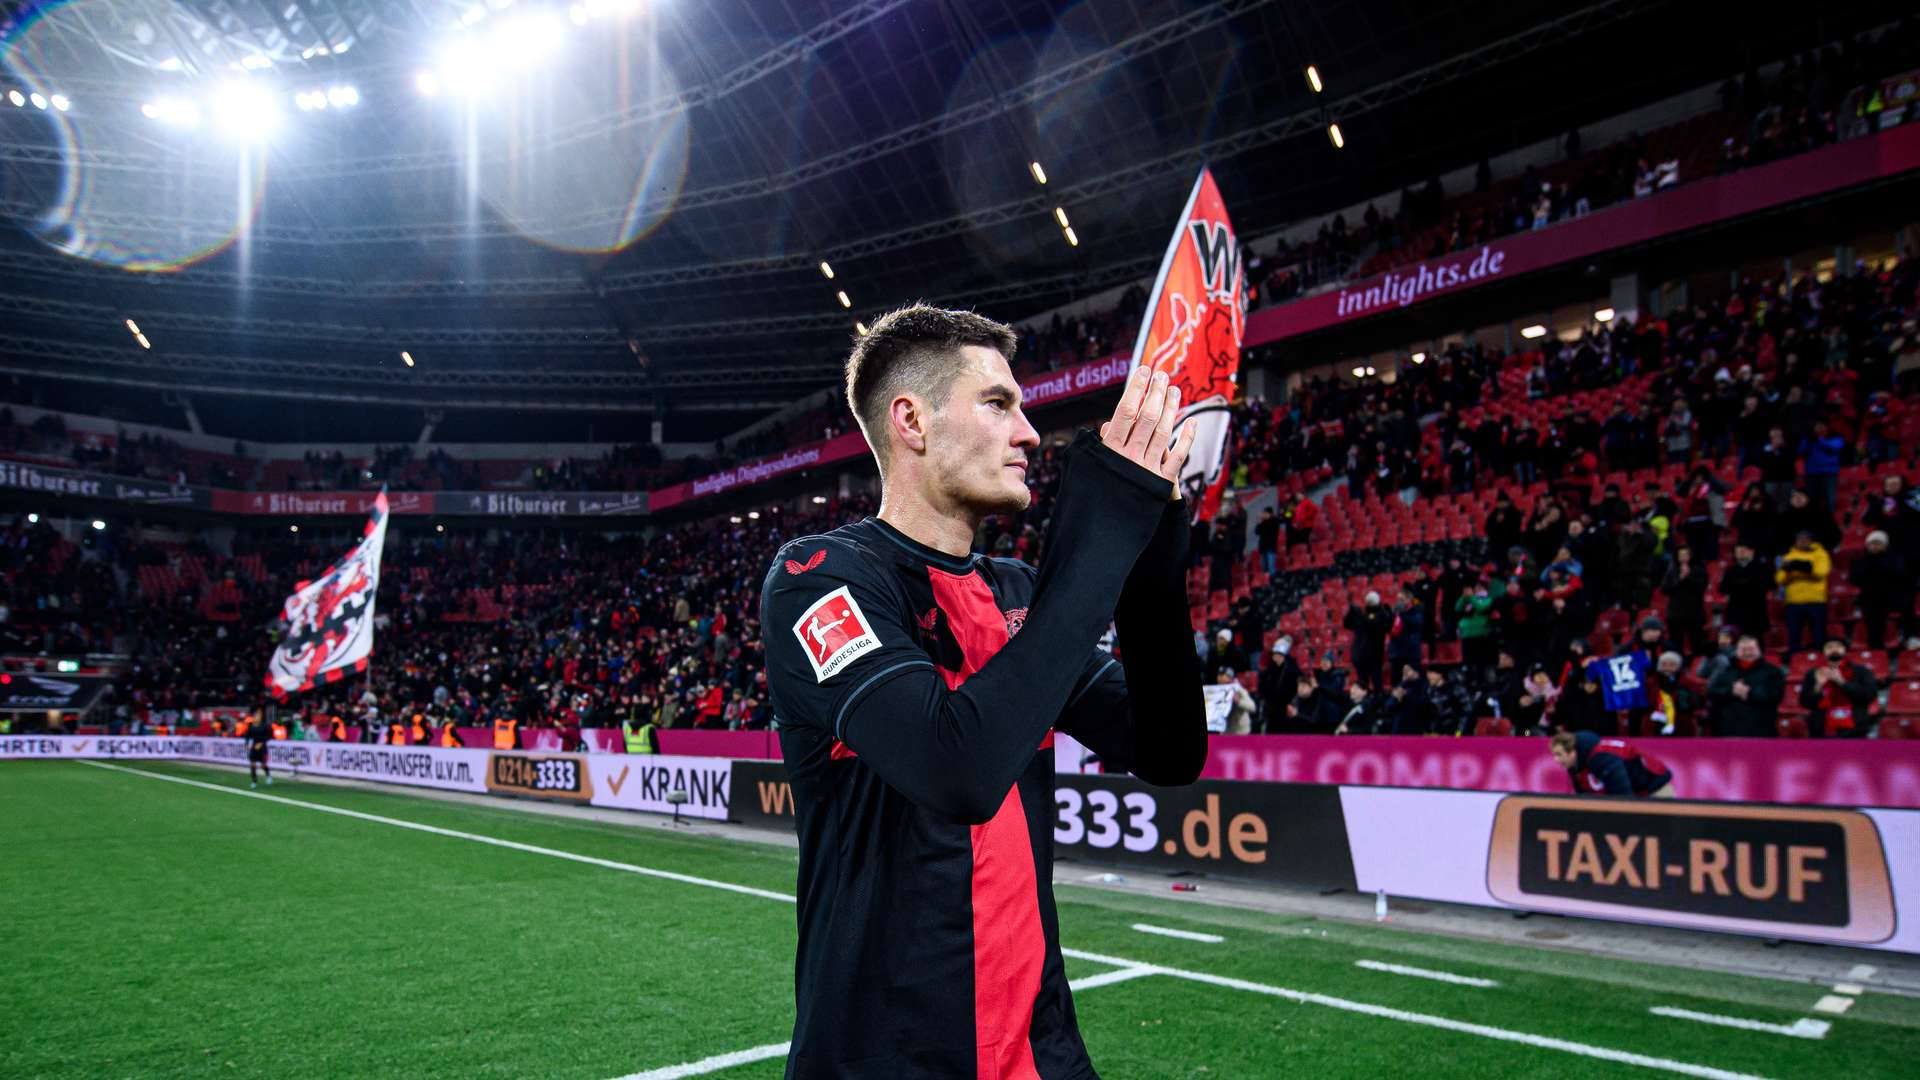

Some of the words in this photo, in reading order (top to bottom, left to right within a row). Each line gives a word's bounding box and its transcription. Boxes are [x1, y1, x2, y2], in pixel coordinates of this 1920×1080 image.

[1337, 246, 1505, 317] innlights.de
[1021, 372, 1071, 403] ormat
[487, 494, 567, 514] Bitburger
[822, 638, 873, 677] BUNDESLIGA
[325, 749, 432, 779] FLUGHAFENTRANSFER
[435, 760, 474, 784] u.v.m.
[641, 765, 730, 809] KRANK
[1217, 749, 1302, 784] THE
[1536, 828, 1828, 903] TAXI-RUF
